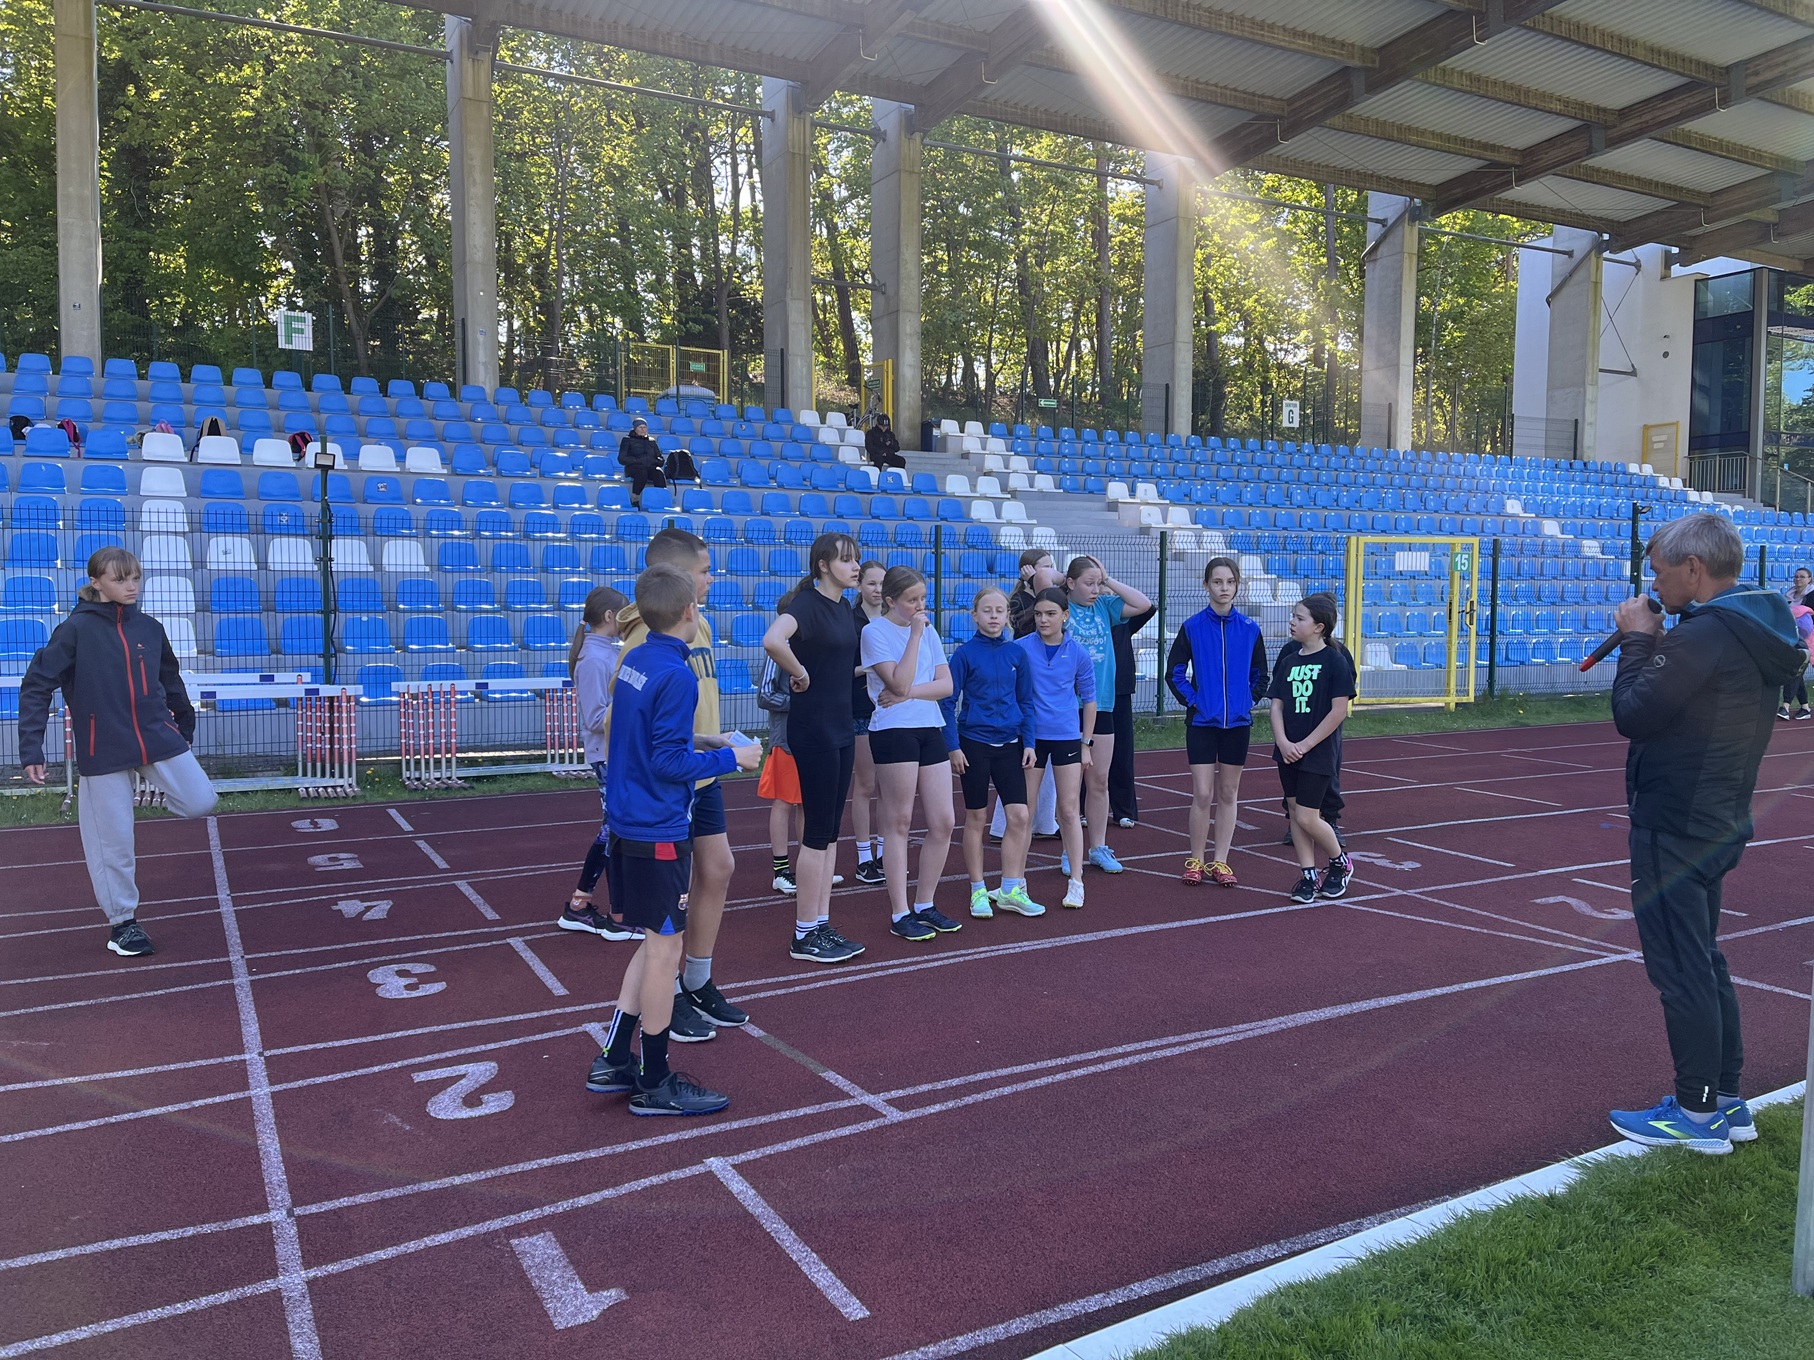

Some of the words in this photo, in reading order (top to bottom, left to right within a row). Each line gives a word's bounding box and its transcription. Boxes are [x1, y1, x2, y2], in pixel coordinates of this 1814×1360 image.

[284, 315, 306, 345] F
[1288, 409, 1294, 424] G
[1455, 554, 1468, 570] 15
[1287, 664, 1322, 681] JUST
[1292, 680, 1313, 697] DO
[1295, 696, 1311, 713] IT.
[307, 852, 364, 872] 5
[331, 899, 394, 921] 4
[366, 962, 447, 999] 3
[411, 1061, 515, 1119] 2
[510, 1231, 629, 1330] 1
